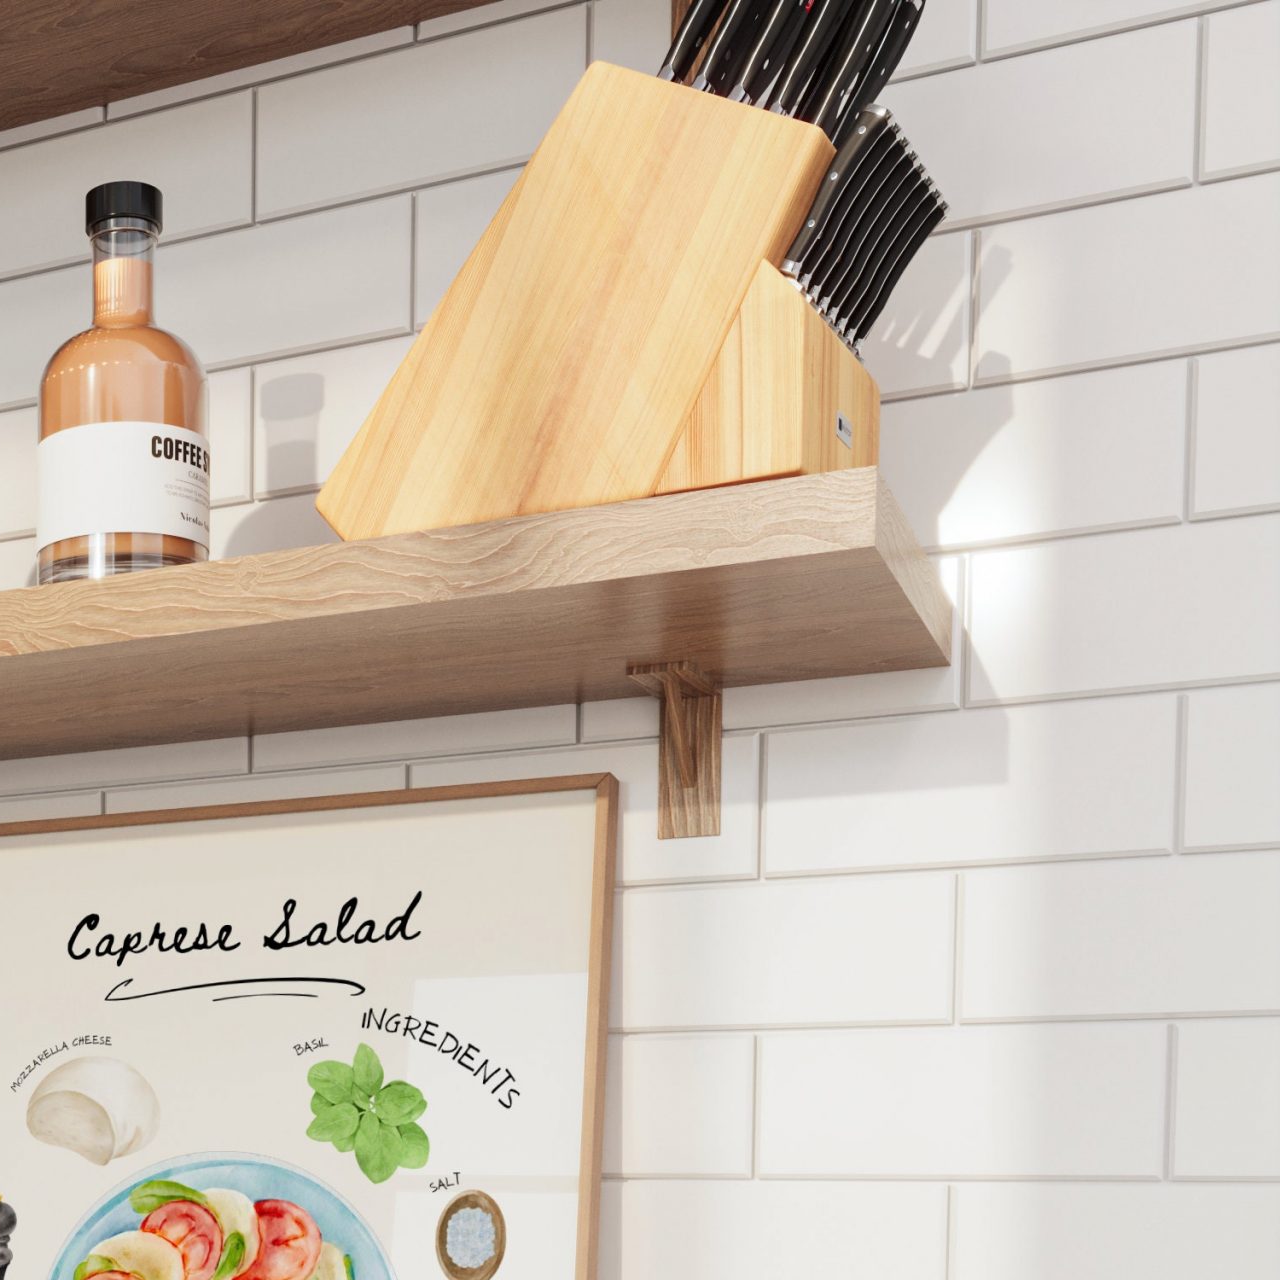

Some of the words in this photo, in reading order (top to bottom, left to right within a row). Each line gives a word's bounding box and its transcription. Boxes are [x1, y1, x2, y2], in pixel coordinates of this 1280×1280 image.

[151, 435, 201, 469] COFFEE
[67, 913, 241, 966] Caprese
[263, 890, 422, 950] Salad
[10, 1041, 70, 1093] MOZZARELLA
[72, 1035, 113, 1047] CHEESE
[293, 1037, 329, 1056] BASIL
[361, 1007, 520, 1109] INGREDIENTS
[429, 1171, 461, 1193] SALT
